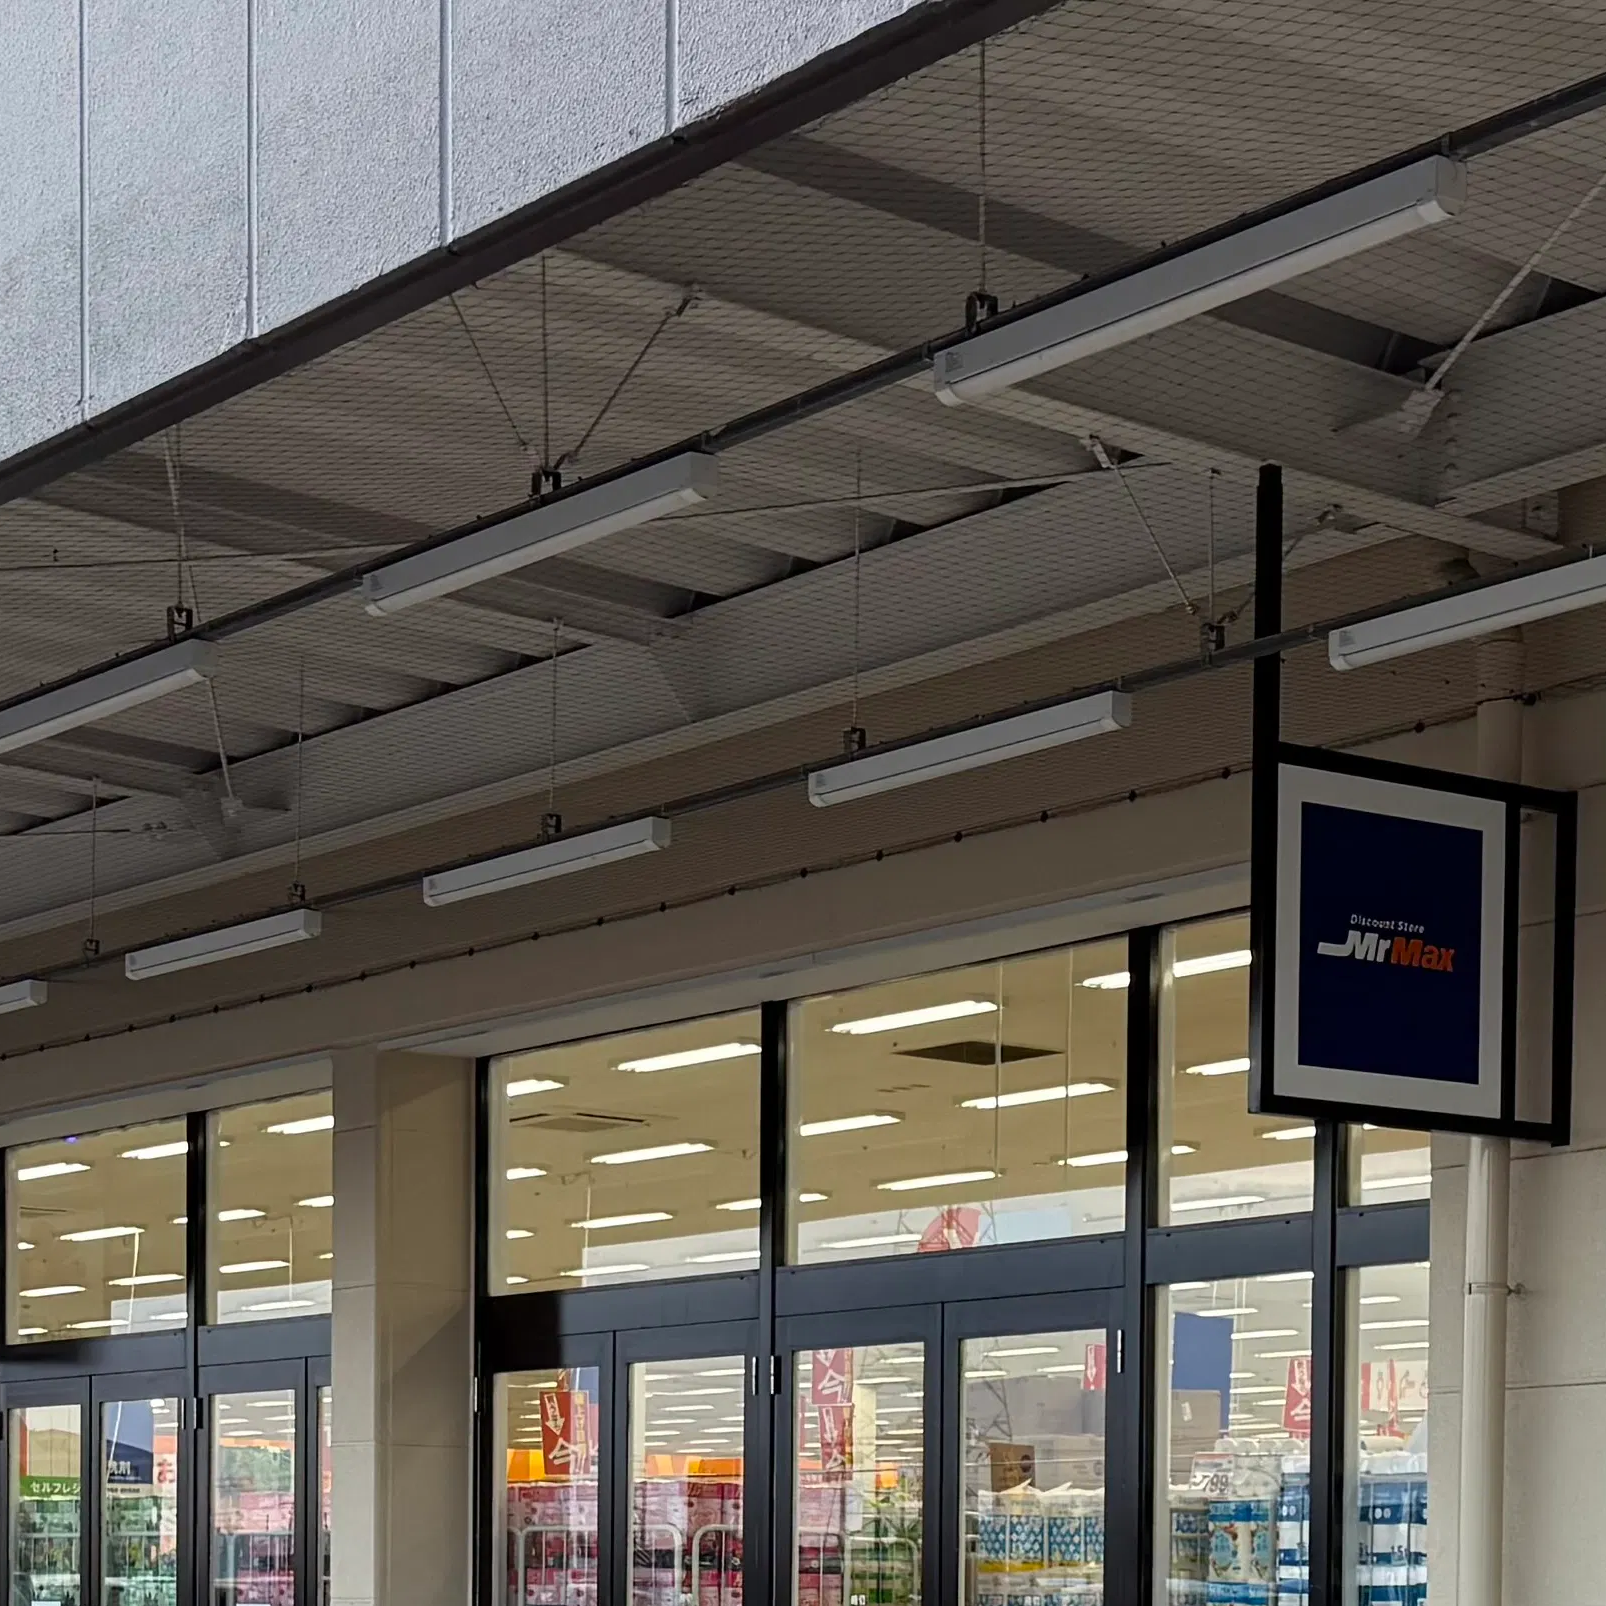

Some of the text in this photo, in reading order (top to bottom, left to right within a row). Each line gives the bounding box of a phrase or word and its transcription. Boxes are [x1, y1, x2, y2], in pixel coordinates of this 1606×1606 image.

[1350, 914, 1425, 933] Discount Store
[1317, 930, 1455, 972] MrMax
